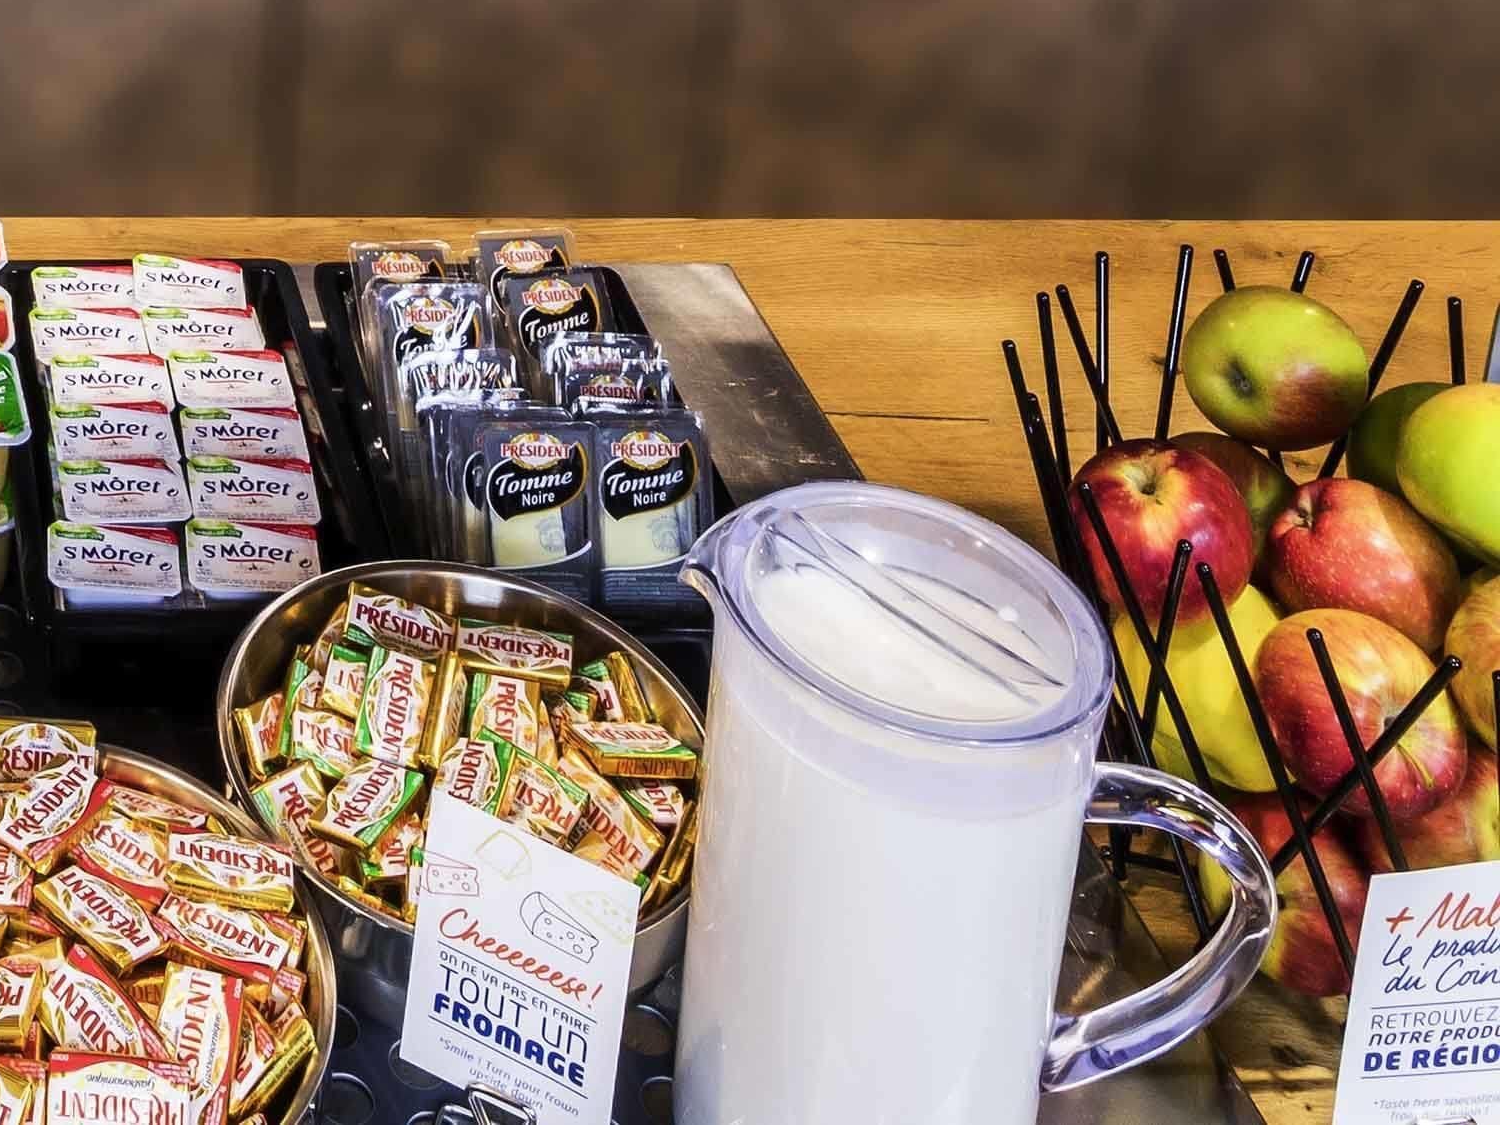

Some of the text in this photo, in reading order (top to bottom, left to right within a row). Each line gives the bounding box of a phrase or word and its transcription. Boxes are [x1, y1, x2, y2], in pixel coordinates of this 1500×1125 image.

[524, 311, 591, 342] Tomme
[495, 469, 573, 495] Tomme
[607, 468, 684, 495] Tomme
[521, 491, 556, 507] Noire
[633, 491, 667, 507] Noire
[1383, 934, 1413, 967] Le
[1384, 965, 1426, 994] du
[461, 959, 477, 977] NE
[482, 968, 498, 988] VA
[502, 981, 527, 1003] PAS
[531, 995, 548, 1013] EN
[552, 1004, 591, 1036] FAIRE
[440, 965, 588, 1064] TOUT UN
[1370, 1006, 1498, 1030] RETROUVEZ
[434, 993, 586, 1089] FROMAGE
[1368, 1030, 1433, 1047] NOTRE
[1363, 1050, 1402, 1072] DE
